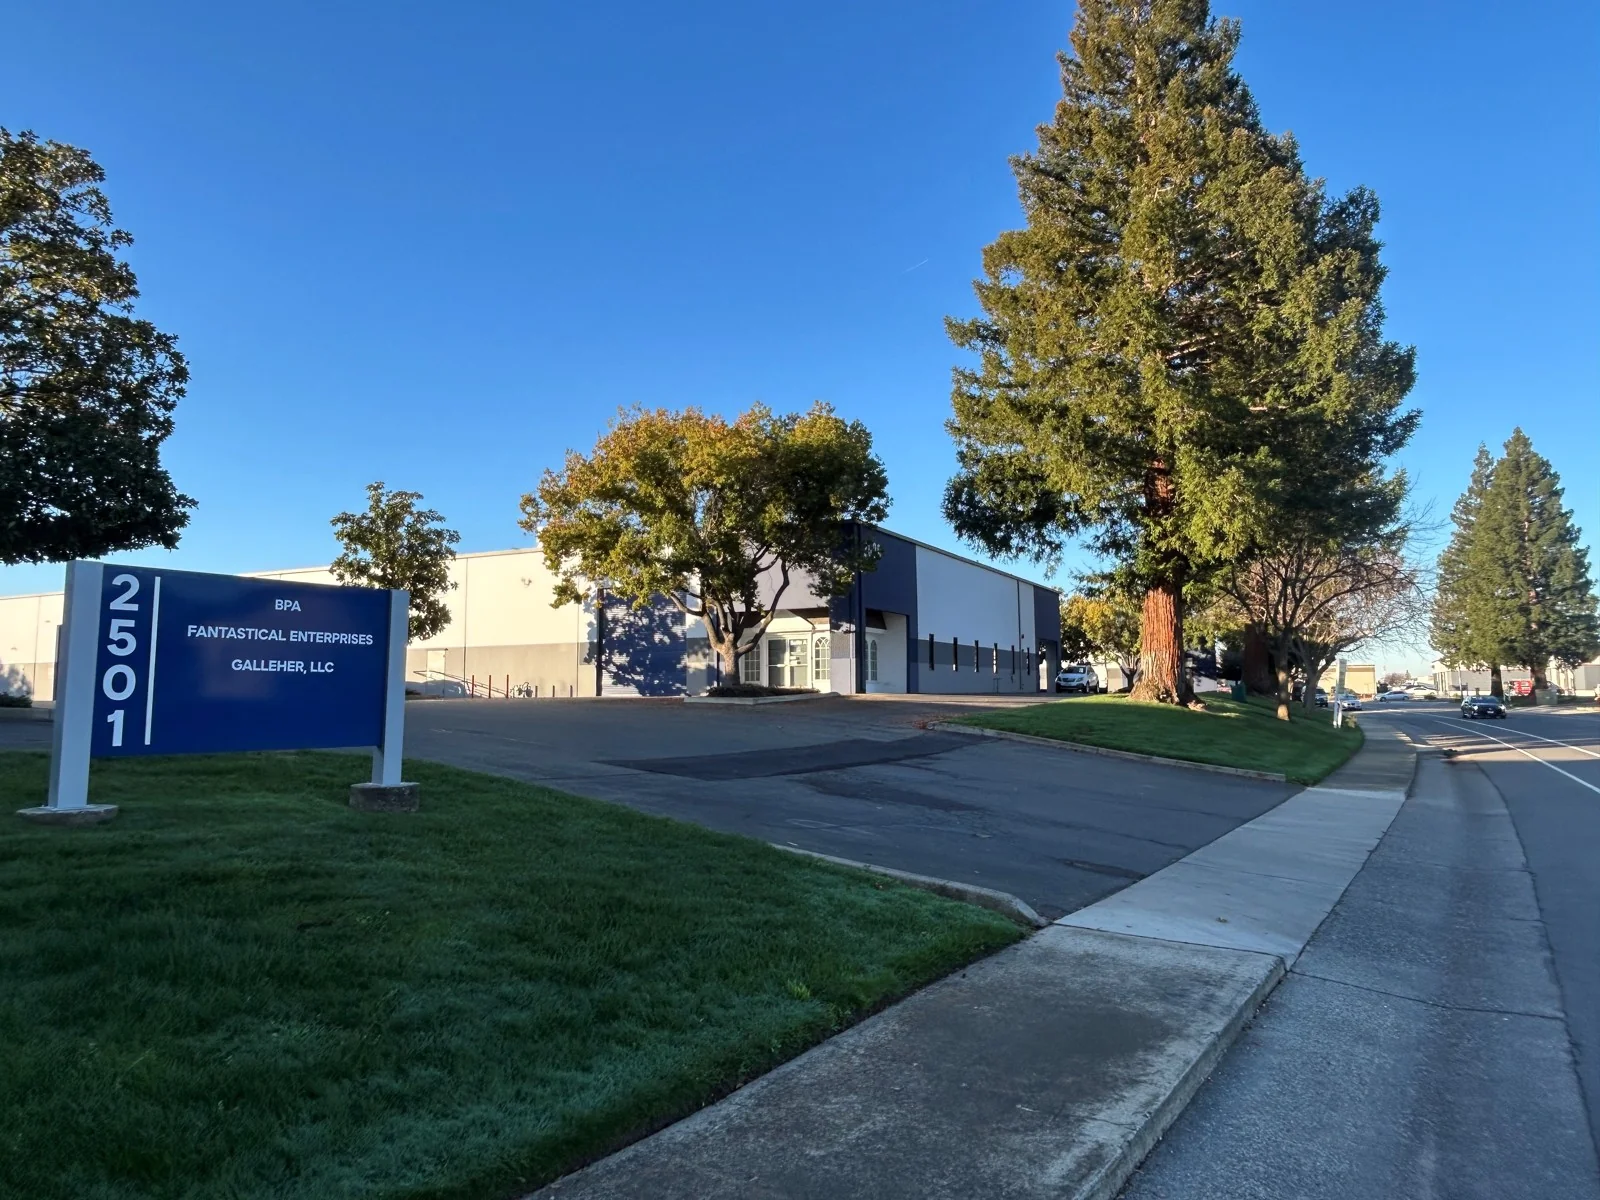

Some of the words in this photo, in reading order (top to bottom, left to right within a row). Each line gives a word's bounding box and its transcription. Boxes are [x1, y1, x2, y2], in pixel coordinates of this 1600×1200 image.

[274, 599, 302, 612] BPA
[187, 625, 287, 641] FANTASTICAL
[289, 630, 373, 645] ENTERPRISES
[103, 574, 140, 747] 2501
[231, 659, 307, 675] GALLEHER,
[310, 661, 335, 673] LLC
